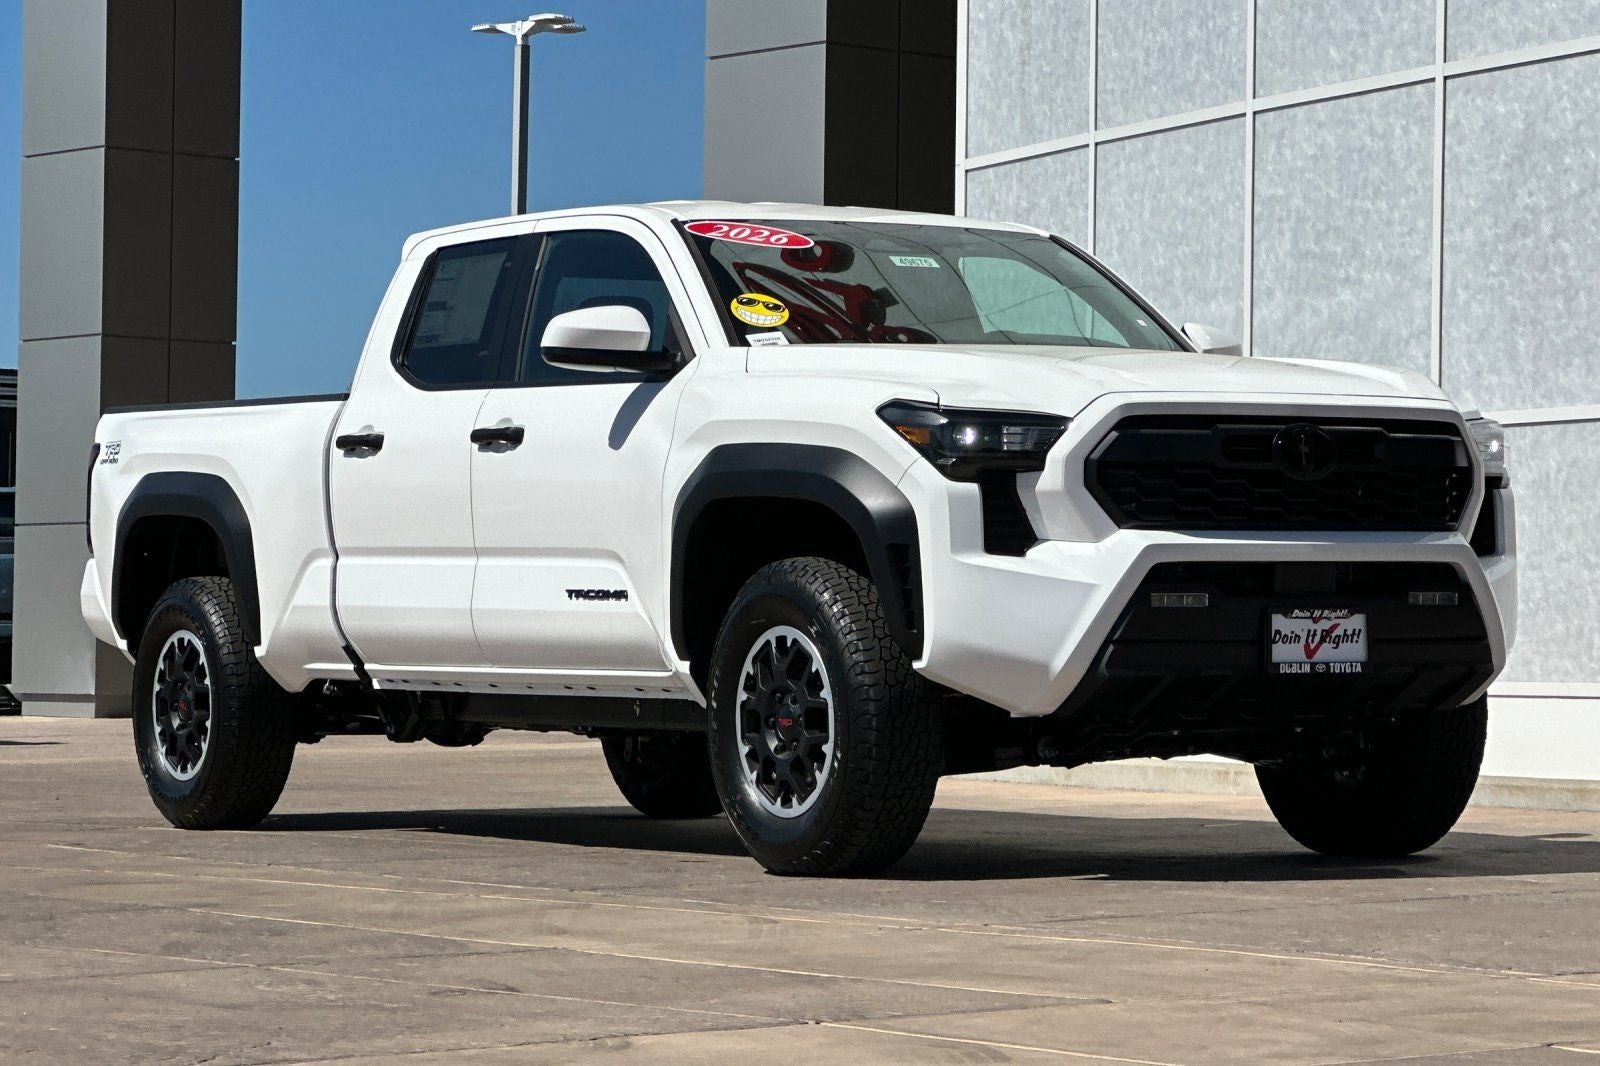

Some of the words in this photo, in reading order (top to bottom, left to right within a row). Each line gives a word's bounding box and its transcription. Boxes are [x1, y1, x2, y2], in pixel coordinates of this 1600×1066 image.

[706, 224, 793, 244] 2026
[899, 258, 933, 267] 49675
[565, 589, 629, 601] TACOMA
[1292, 609, 1313, 618] Doin'
[1322, 609, 1348, 620] Right!
[1272, 629, 1304, 645] Doin'
[1305, 629, 1318, 644] It
[1320, 629, 1362, 649] Right!
[1280, 662, 1311, 674] DUBLIN
[1329, 662, 1362, 673] TOYOTA
